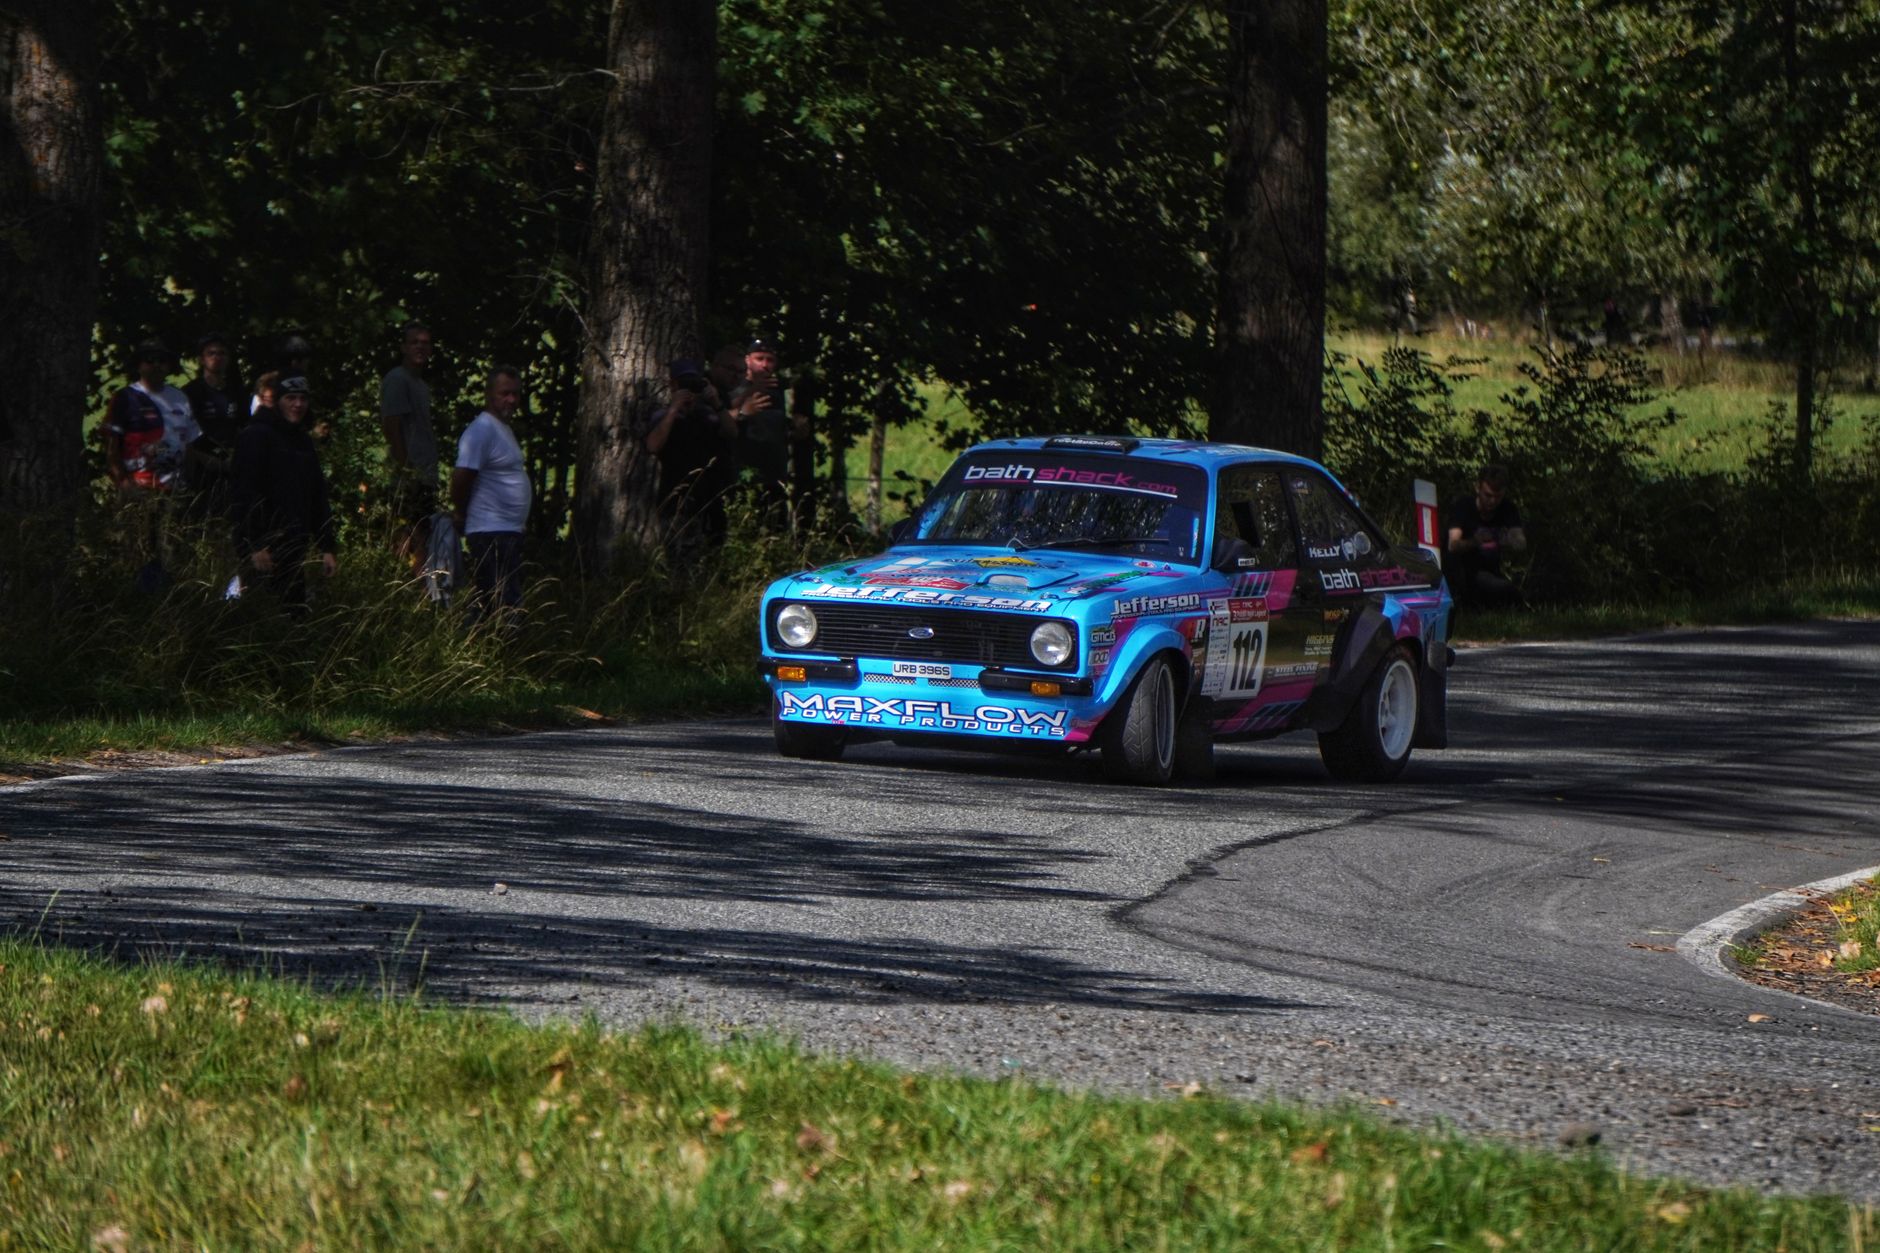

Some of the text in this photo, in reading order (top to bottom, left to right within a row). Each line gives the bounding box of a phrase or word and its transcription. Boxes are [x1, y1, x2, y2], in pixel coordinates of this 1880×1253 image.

[1309, 546, 1341, 558] KELLY
[801, 584, 1052, 610] Jefferson
[1111, 594, 1200, 615] Jefferson
[893, 664, 950, 676] URB 396S
[1230, 629, 1262, 690] 112
[782, 692, 1069, 726] MAXFLOW
[782, 708, 1064, 736] POWER PRODUCTS
